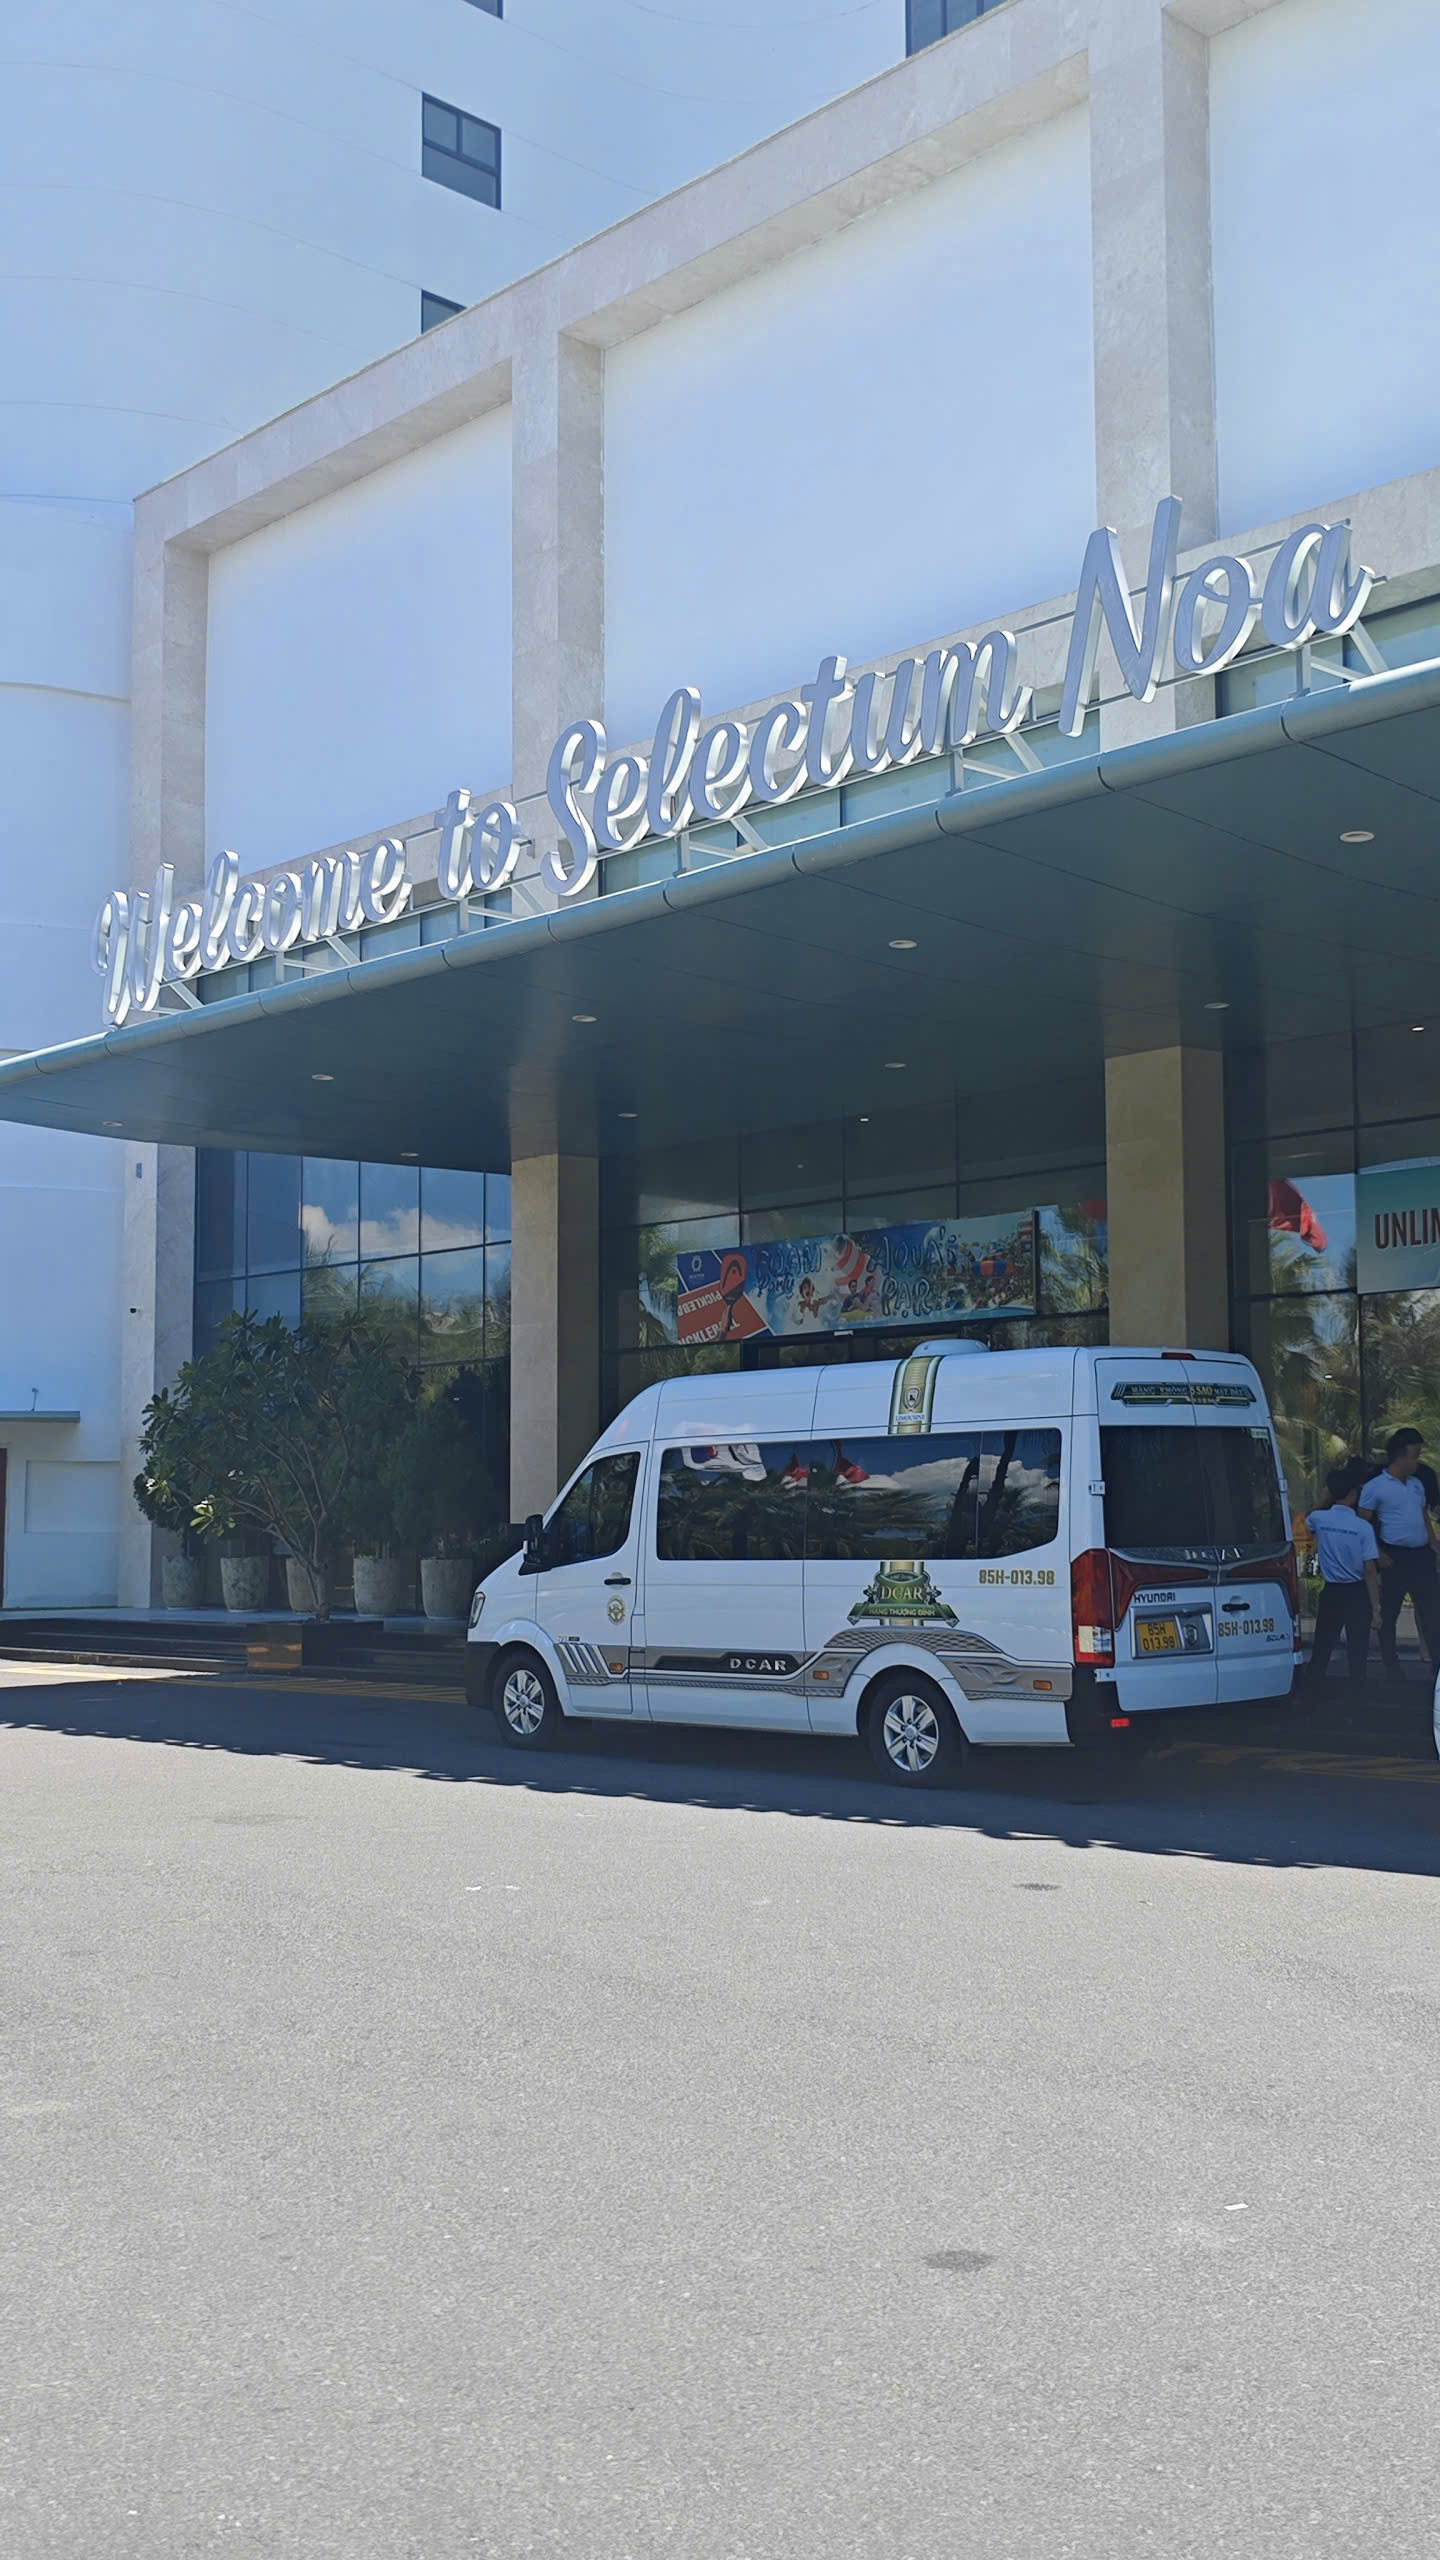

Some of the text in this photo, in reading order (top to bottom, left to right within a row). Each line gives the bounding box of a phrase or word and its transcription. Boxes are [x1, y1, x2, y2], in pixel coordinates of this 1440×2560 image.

[91, 495, 1376, 1026] Welcome to Selectum Noa
[755, 1242, 822, 1277] FOAM
[881, 1276, 939, 1317] PAR
[979, 1569, 1055, 1585] 85H-013.98
[881, 1585, 924, 1601] DCAR
[1134, 1592, 1176, 1604] HYUNDAI
[1148, 1623, 1166, 1635] 85H
[1218, 1618, 1275, 1637] 85H-013.98
[1143, 1635, 1175, 1651] 013.98
[730, 1658, 787, 1671] DCAR
